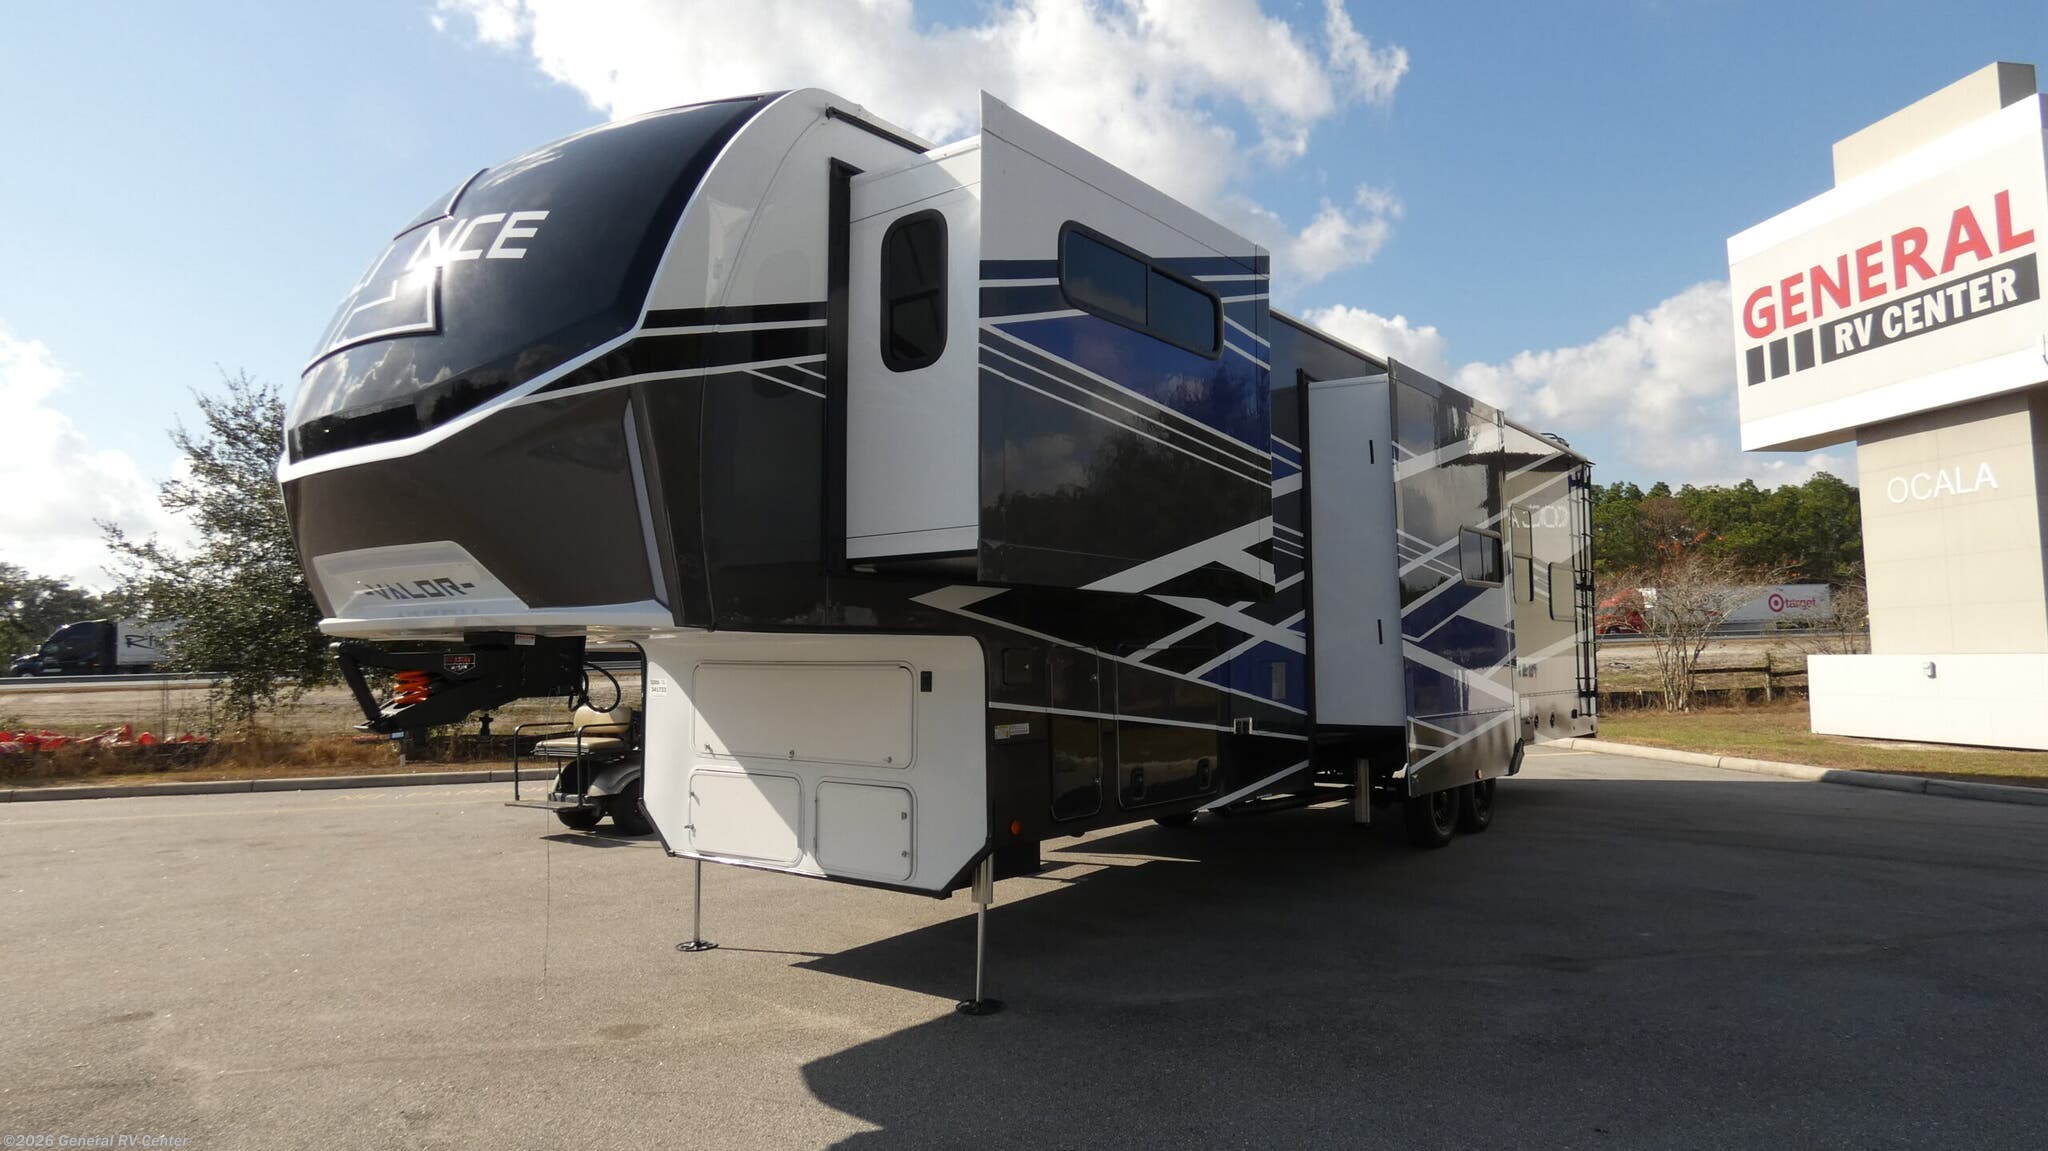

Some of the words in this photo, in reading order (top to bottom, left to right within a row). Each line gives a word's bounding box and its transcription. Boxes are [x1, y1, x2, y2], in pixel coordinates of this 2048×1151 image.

[1743, 189, 2034, 340] GENERAL
[1834, 312, 1873, 355] RV
[1882, 268, 2018, 339] CENTER
[1887, 461, 1999, 505] OCALA
[1785, 597, 1816, 610] target
